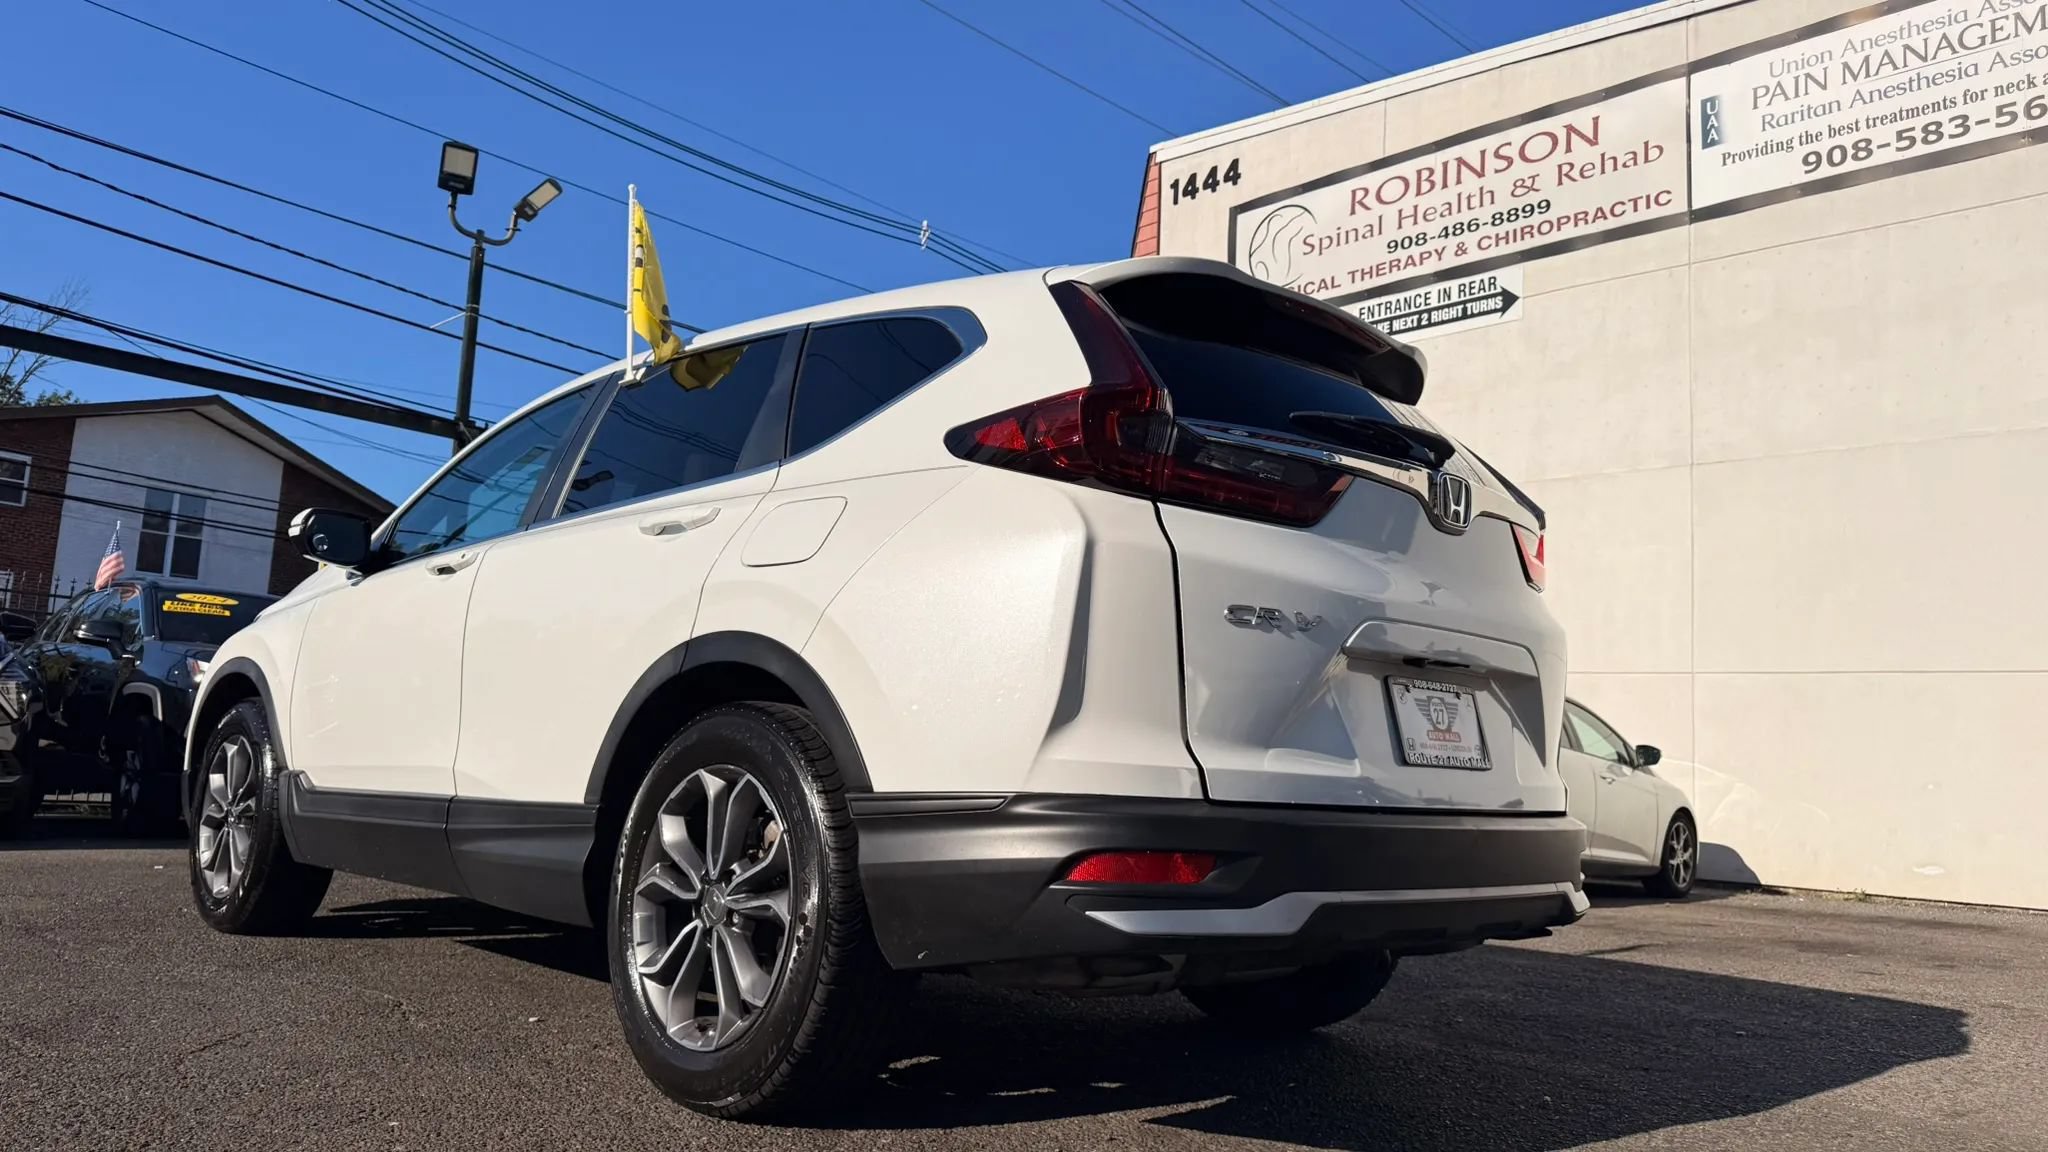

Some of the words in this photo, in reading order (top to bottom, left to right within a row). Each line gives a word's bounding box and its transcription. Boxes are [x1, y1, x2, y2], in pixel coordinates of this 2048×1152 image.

[1751, 66, 1829, 111] PAIN
[1841, 4, 2048, 86] MANAGEM
[1769, 49, 1833, 78] Union
[1840, 8, 1969, 59] Anesthesia
[1721, 136, 1794, 167] Providing
[1799, 128, 1823, 147] the
[1827, 117, 1861, 140] best
[1865, 94, 1957, 129] treatments
[1962, 87, 1988, 106] for
[1993, 72, 2038, 98] neck
[1761, 99, 1842, 132] Raritan
[1848, 61, 1979, 109] Anesthesia
[1987, 44, 2048, 73] Asso
[1349, 115, 1601, 216] ROBINSON
[1801, 94, 2048, 174] 908-583-56
[1169, 158, 1242, 205] 1444
[1302, 214, 1383, 257] Spinal
[1396, 185, 1496, 230] Health
[1510, 173, 1541, 198] &
[1556, 140, 1664, 187] Rehab
[1347, 246, 1447, 284] THERAPY
[1454, 241, 1468, 257] &
[1477, 189, 1672, 251] CHIROPRACTIC
[1386, 198, 1551, 254] 908-486-8899
[1359, 291, 1432, 320] ENTRANCE
[1437, 286, 1452, 304] IN
[1457, 275, 1497, 299] REAR
[1392, 314, 1419, 332] NEXT
[1420, 312, 1429, 326] 2
[1431, 307, 1463, 323] RIGHT
[1465, 295, 1504, 316] TURNS
[1433, 708, 1445, 726] 27
